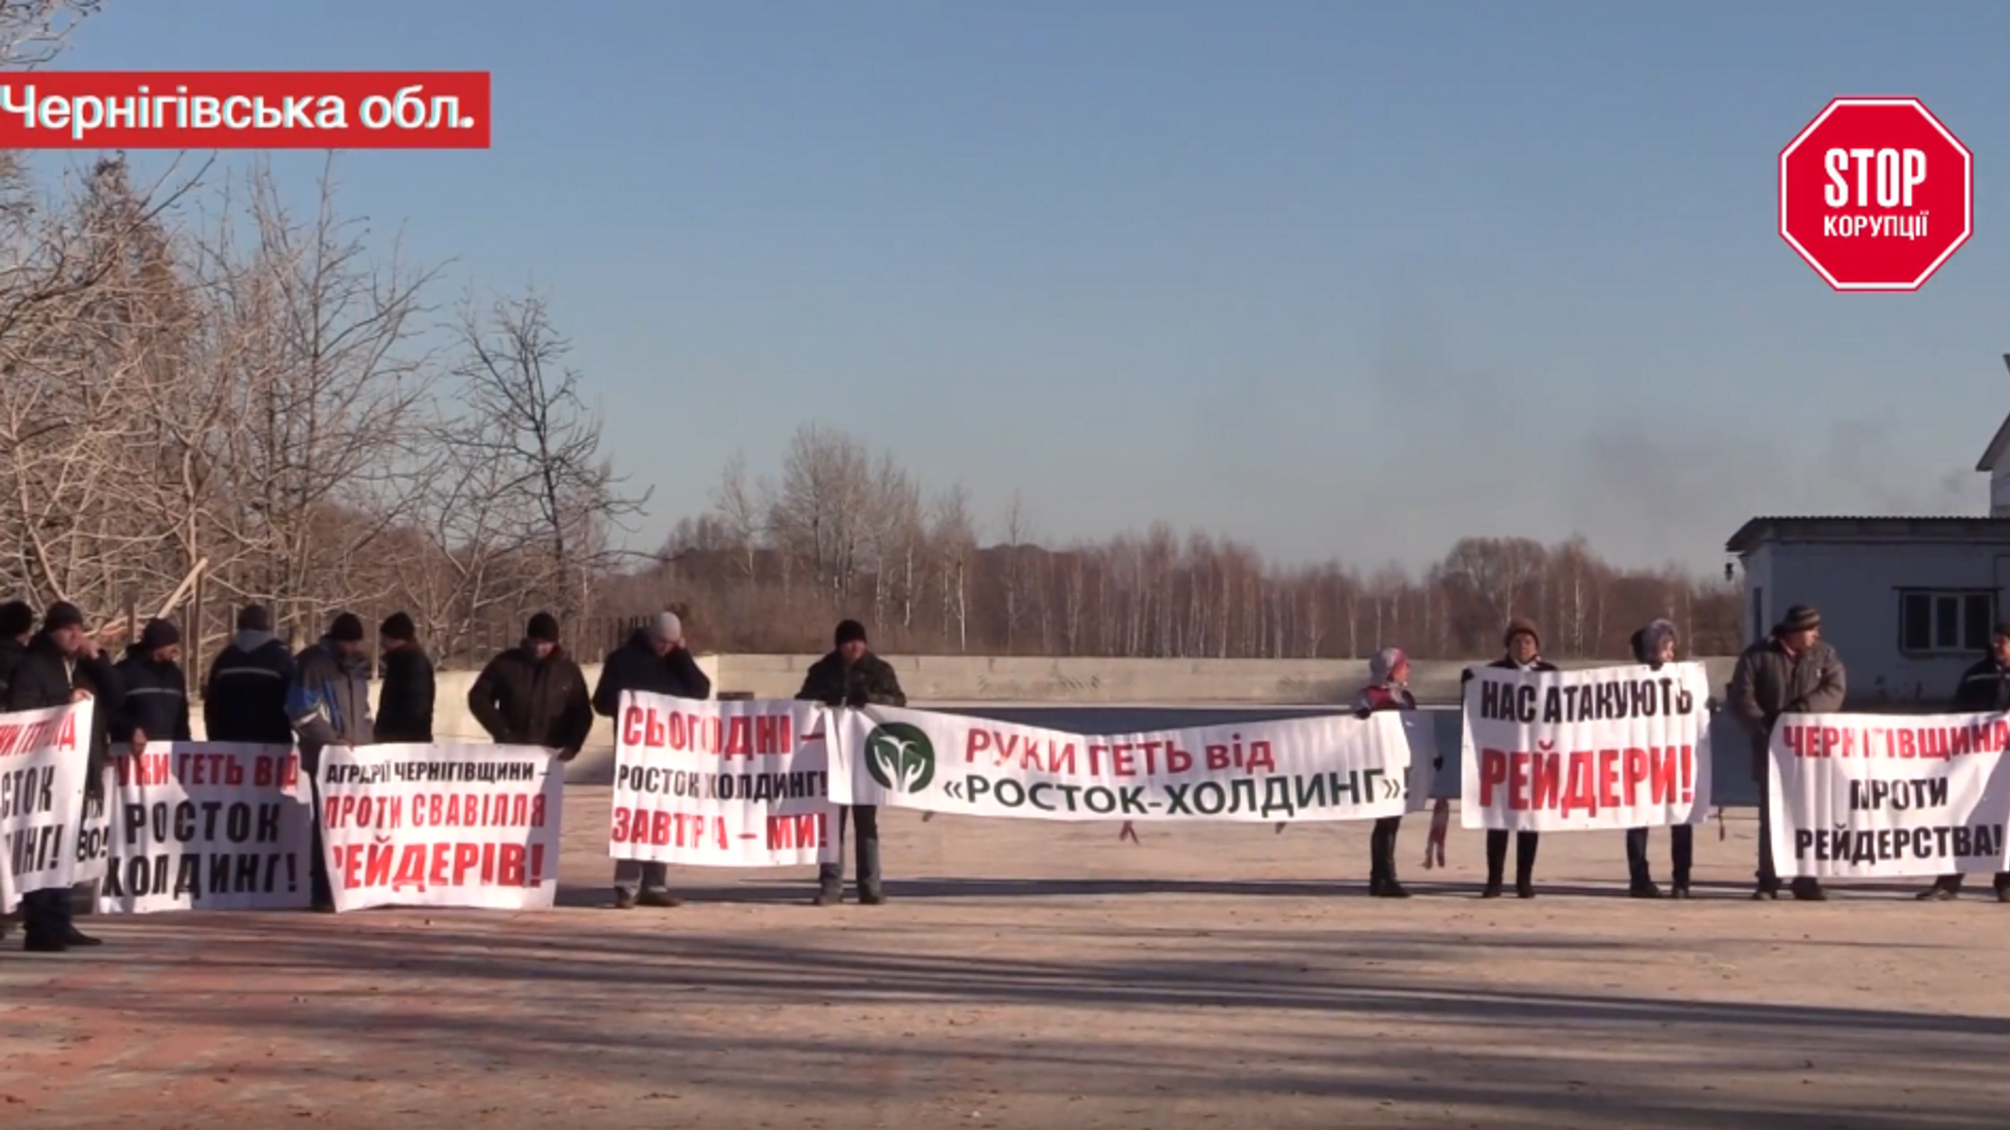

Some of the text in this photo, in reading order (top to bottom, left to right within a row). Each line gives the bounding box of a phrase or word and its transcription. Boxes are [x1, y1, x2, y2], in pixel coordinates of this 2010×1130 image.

[1480, 677, 1693, 724] НАС АТАКУЮТЬ
[623, 705, 792, 761] СЬОГОДНІ
[965, 728, 1275, 777] РУКИ ГЕТЬ від
[178, 753, 244, 786] ГЕТЬ
[254, 755, 299, 789] ВІД
[394, 761, 535, 784] ЧЕРНІГІВЩИНИ
[617, 764, 828, 803] РОСТОК ХОЛДИНГ!
[1479, 740, 1693, 819] РЕЙДЕРИ!
[325, 793, 547, 829] ПРОТИ СВАВІЛЛЯ
[1850, 777, 1948, 811] ПРОТИ
[125, 801, 281, 844] РОСТОК
[611, 806, 729, 851] ЗАВТРА
[766, 813, 828, 851] МИ!
[1795, 823, 2002, 866] РЕЙДЕРСТВА!
[101, 852, 297, 901] ХОЛДИНГ!
